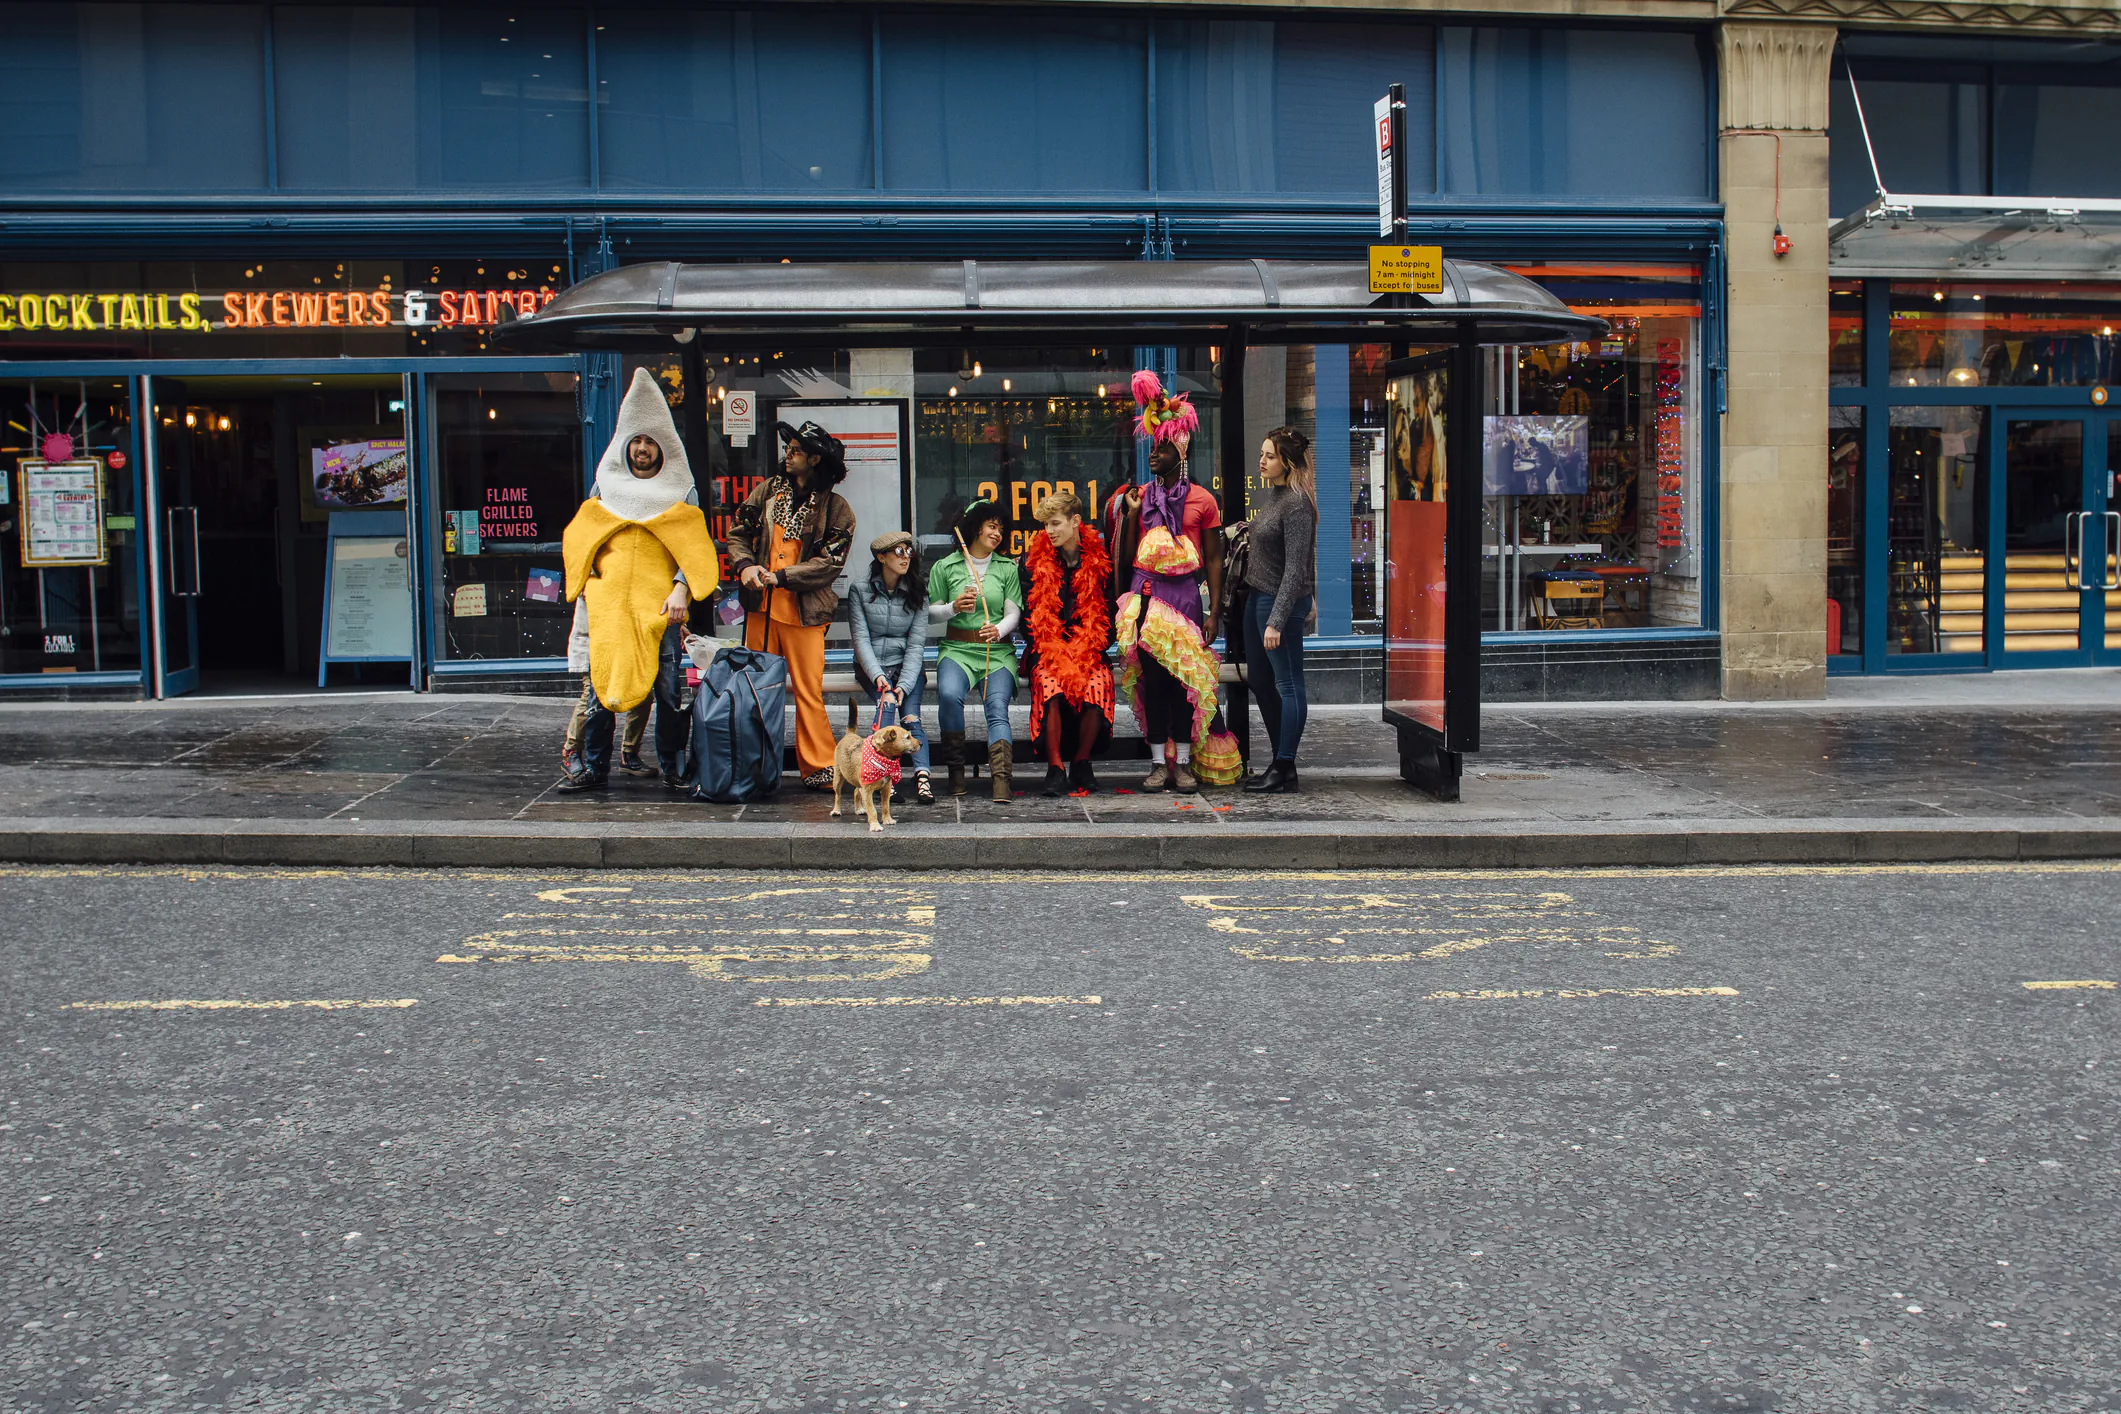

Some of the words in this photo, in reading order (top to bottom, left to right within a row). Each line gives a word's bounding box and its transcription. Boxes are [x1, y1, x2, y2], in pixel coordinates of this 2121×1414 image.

[1382, 121, 1389, 146] B
[1396, 260, 1430, 268] stopping
[1400, 271, 1435, 279] midnight
[1373, 281, 1400, 289] Except
[1402, 281, 1414, 289] for
[1416, 281, 1440, 289] buses
[223, 291, 392, 328] SKEWERS
[403, 289, 428, 327] &
[1657, 337, 1683, 399] FOOD
[486, 487, 528, 502] FLAME
[1087, 479, 1098, 520] 1
[482, 505, 533, 519] GRILLED
[479, 522, 538, 537] SKEWERS
[1657, 496, 1681, 548] THAI
[52, 635, 67, 645] FOR
[435, 886, 937, 983] STOP
